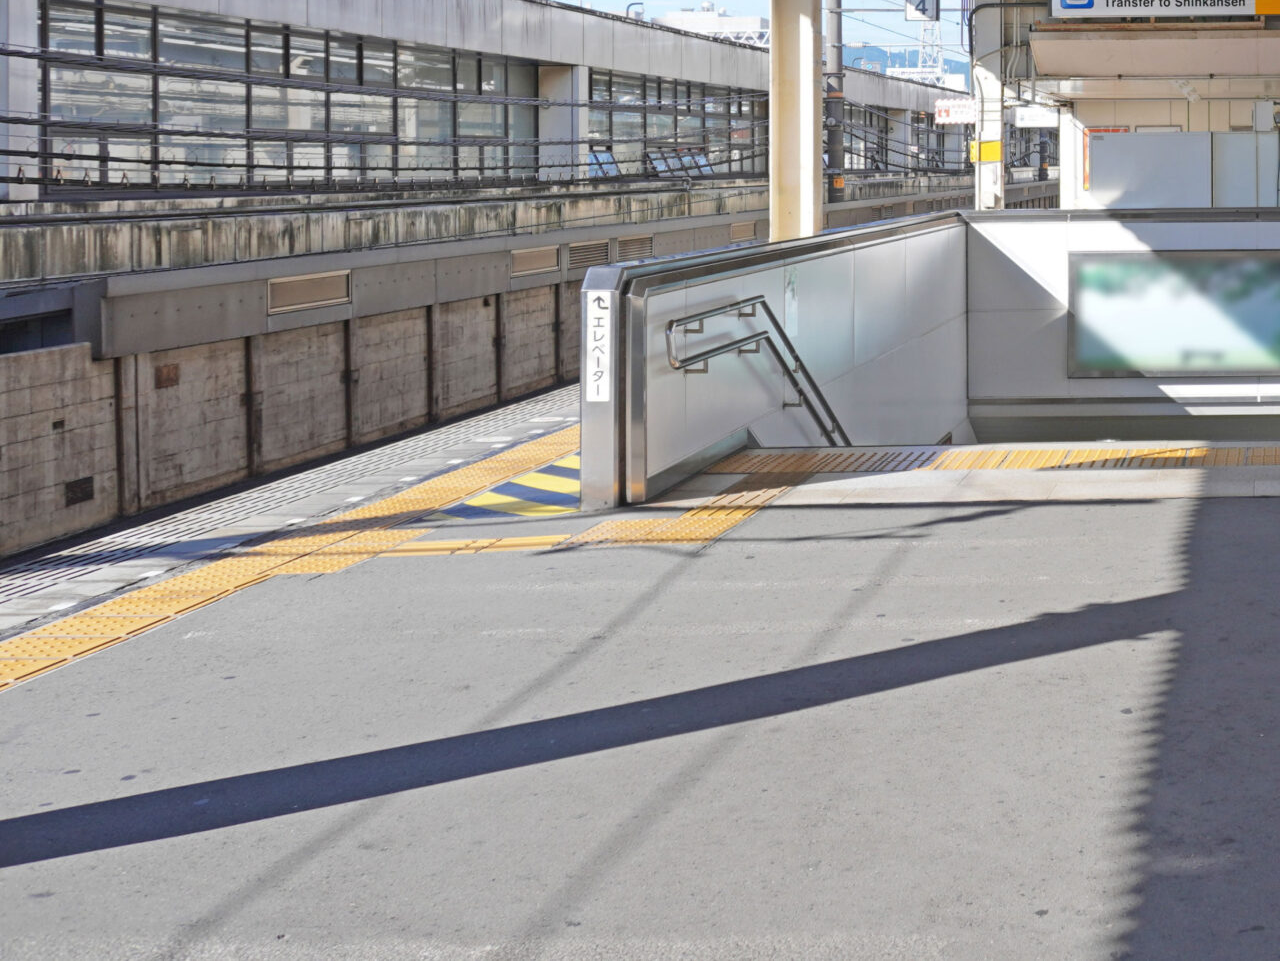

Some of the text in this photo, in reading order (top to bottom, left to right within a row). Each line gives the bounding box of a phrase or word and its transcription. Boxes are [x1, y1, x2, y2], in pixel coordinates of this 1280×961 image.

[592, 317, 605, 395] エレベーター
